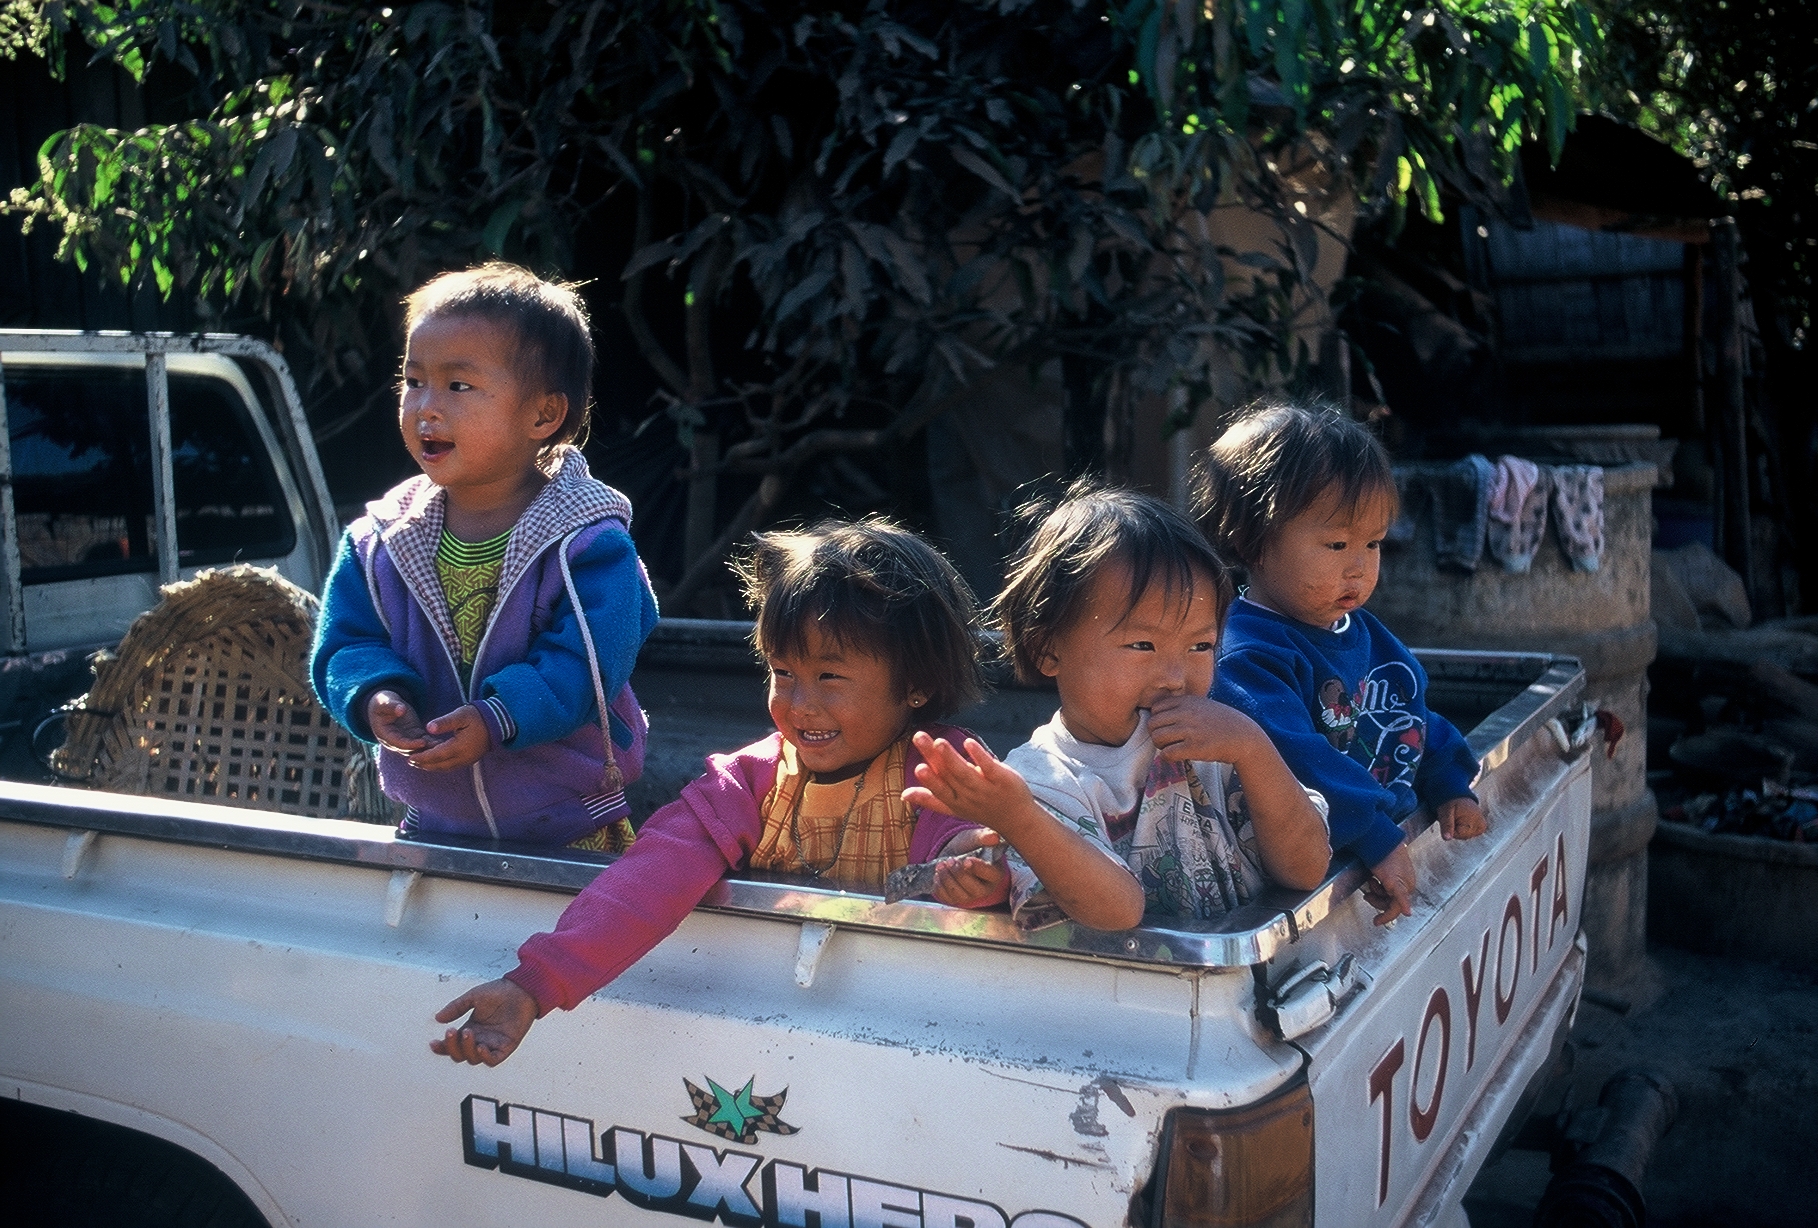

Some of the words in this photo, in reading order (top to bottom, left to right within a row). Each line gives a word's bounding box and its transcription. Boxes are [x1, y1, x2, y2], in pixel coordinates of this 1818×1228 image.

[1367, 831, 1568, 1210] TOYOTA
[460, 1093, 766, 1228] HILUX
[761, 1157, 1093, 1228] HER
